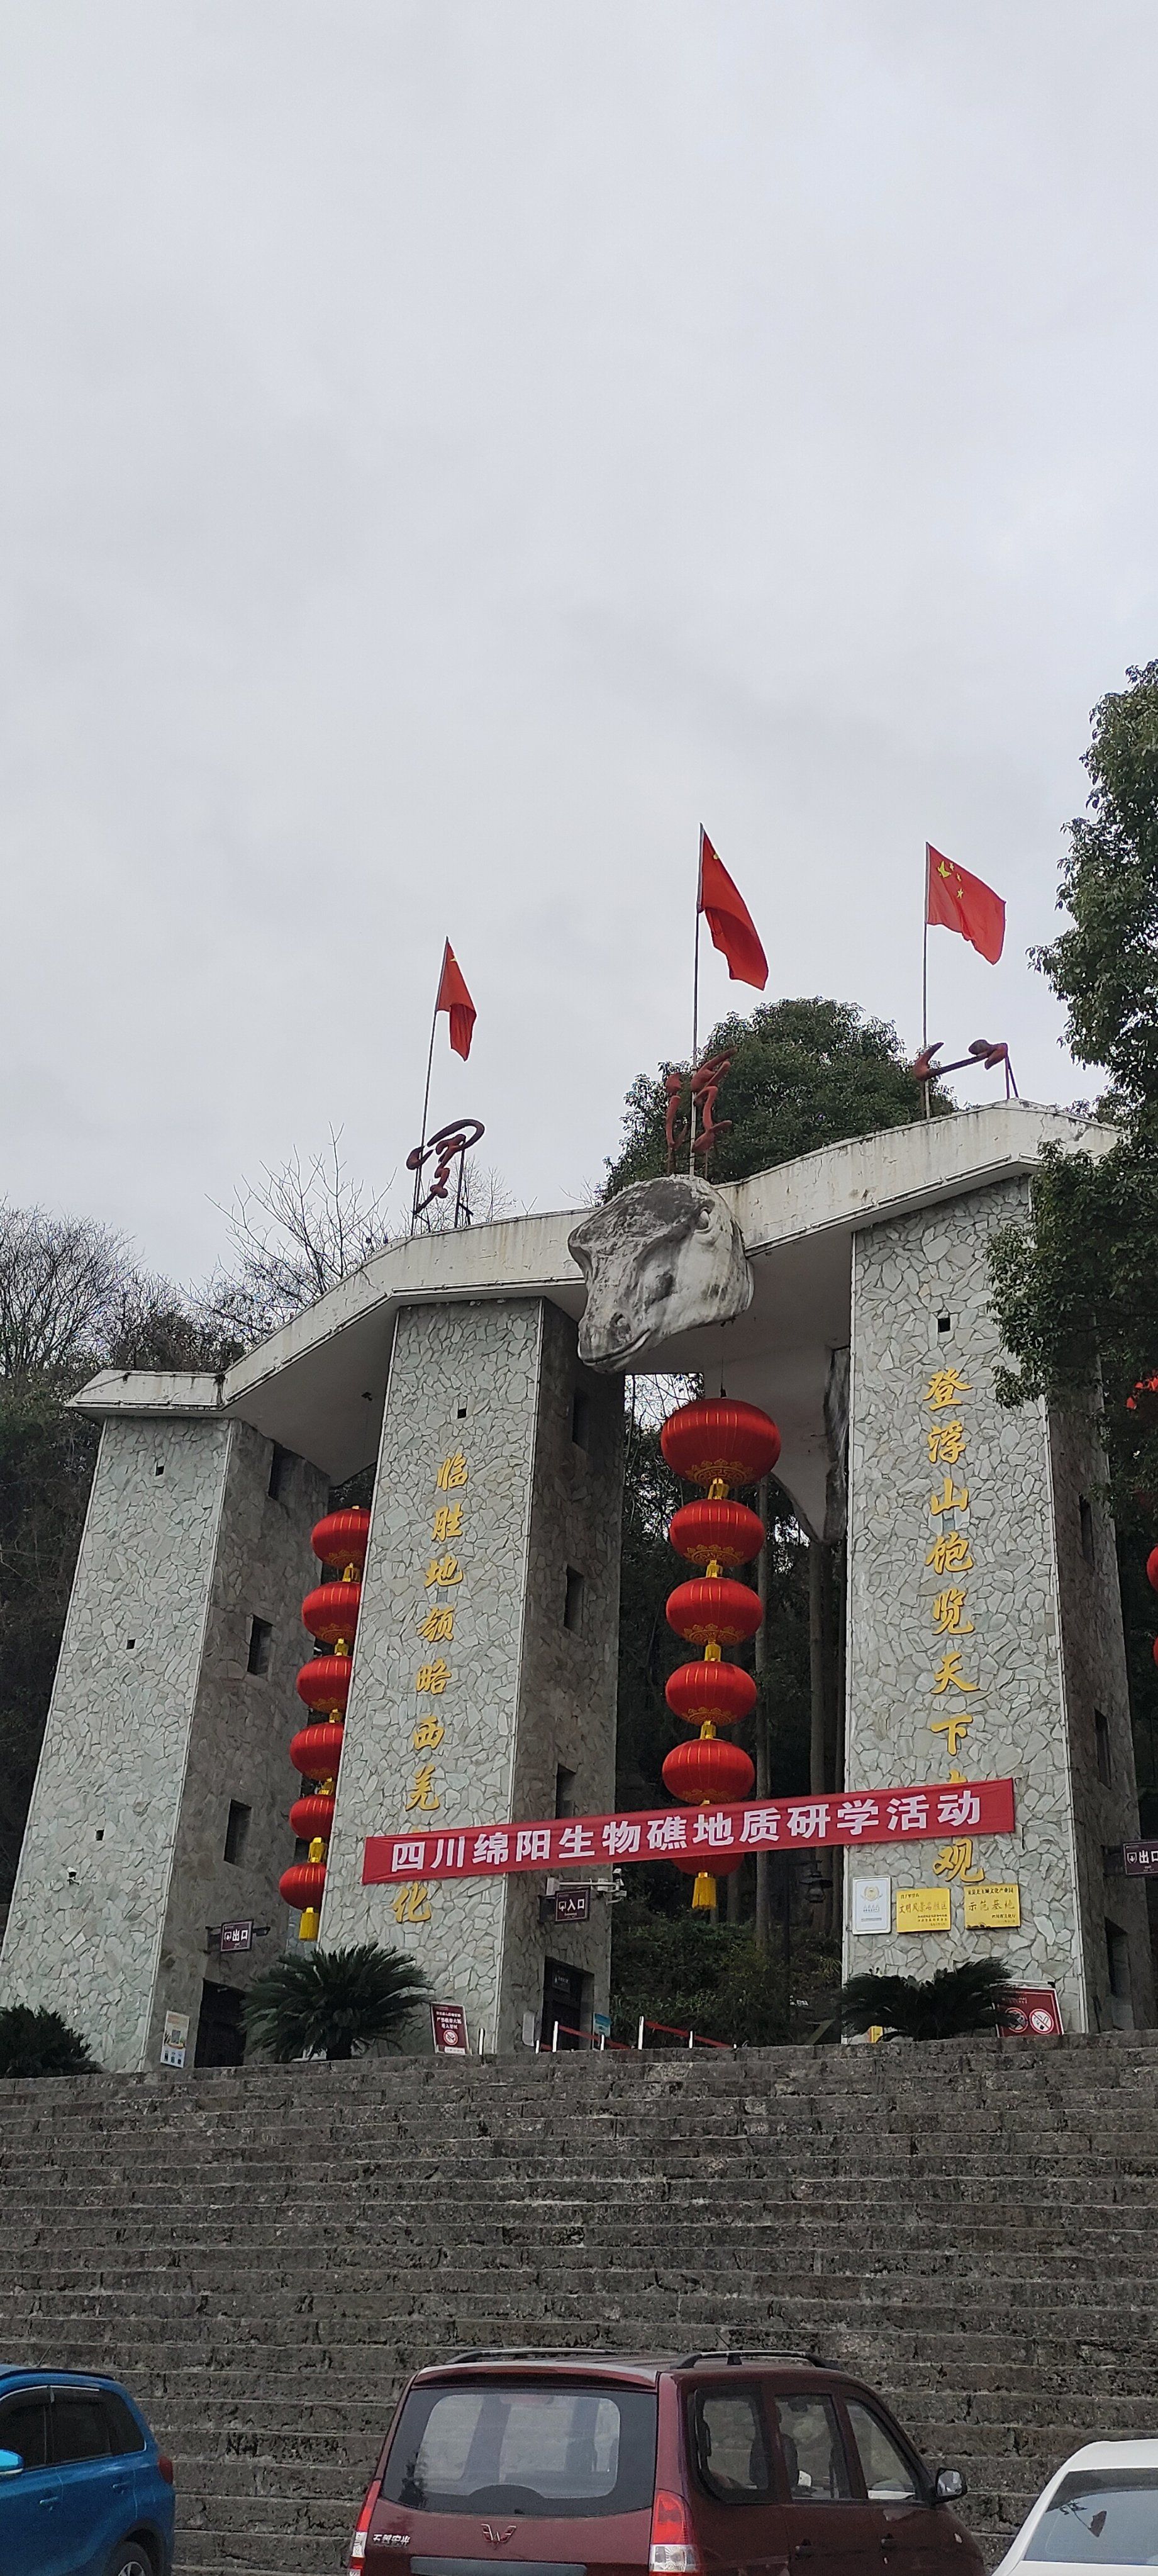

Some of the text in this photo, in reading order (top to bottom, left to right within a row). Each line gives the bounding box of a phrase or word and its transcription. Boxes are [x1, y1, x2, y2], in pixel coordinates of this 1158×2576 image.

[922, 1367, 985, 1883] 登浮山饱览天下观
[391, 1452, 468, 1924] 临胜地领略西羌化
[391, 1789, 981, 1873] 四川绵阳生物礁地质研学活动
[1139, 1849, 1158, 1864] 出口
[567, 1898, 585, 1912] 入口
[968, 1899, 1015, 1912] 示范基地
[232, 1929, 248, 1941] 出口
